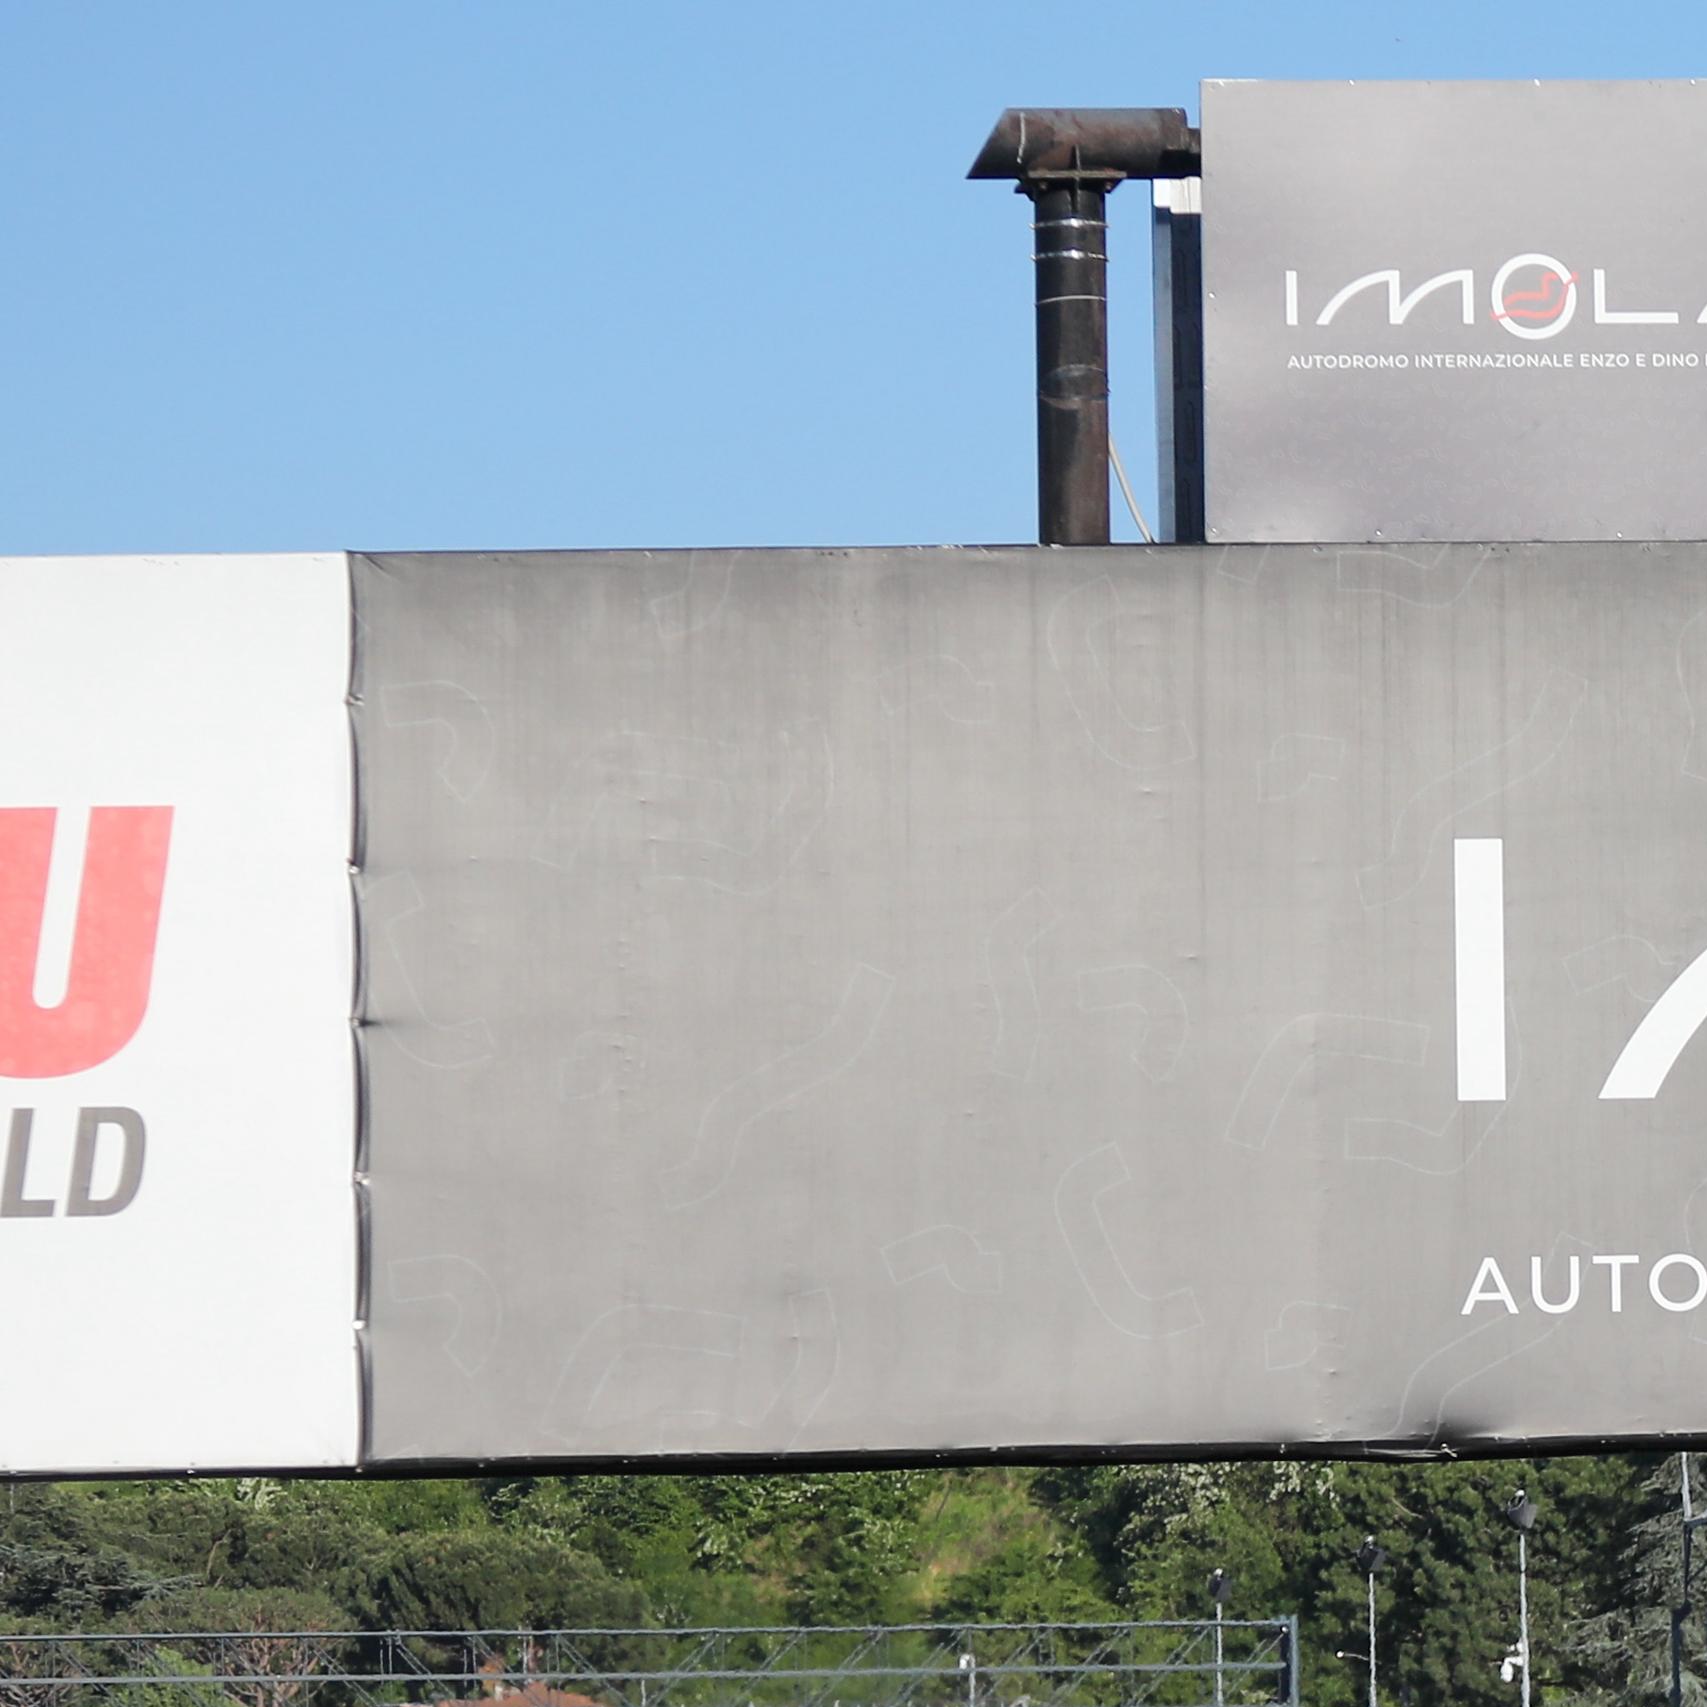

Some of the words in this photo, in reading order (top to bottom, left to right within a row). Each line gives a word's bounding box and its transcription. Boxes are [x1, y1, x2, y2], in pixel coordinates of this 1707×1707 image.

[1288, 354, 1410, 370] AUTODROMO
[1415, 353, 1575, 370] INTERNAZIONALE
[1580, 353, 1631, 369] ENZO
[1636, 353, 1648, 369] E
[1653, 353, 1700, 369] DINO
